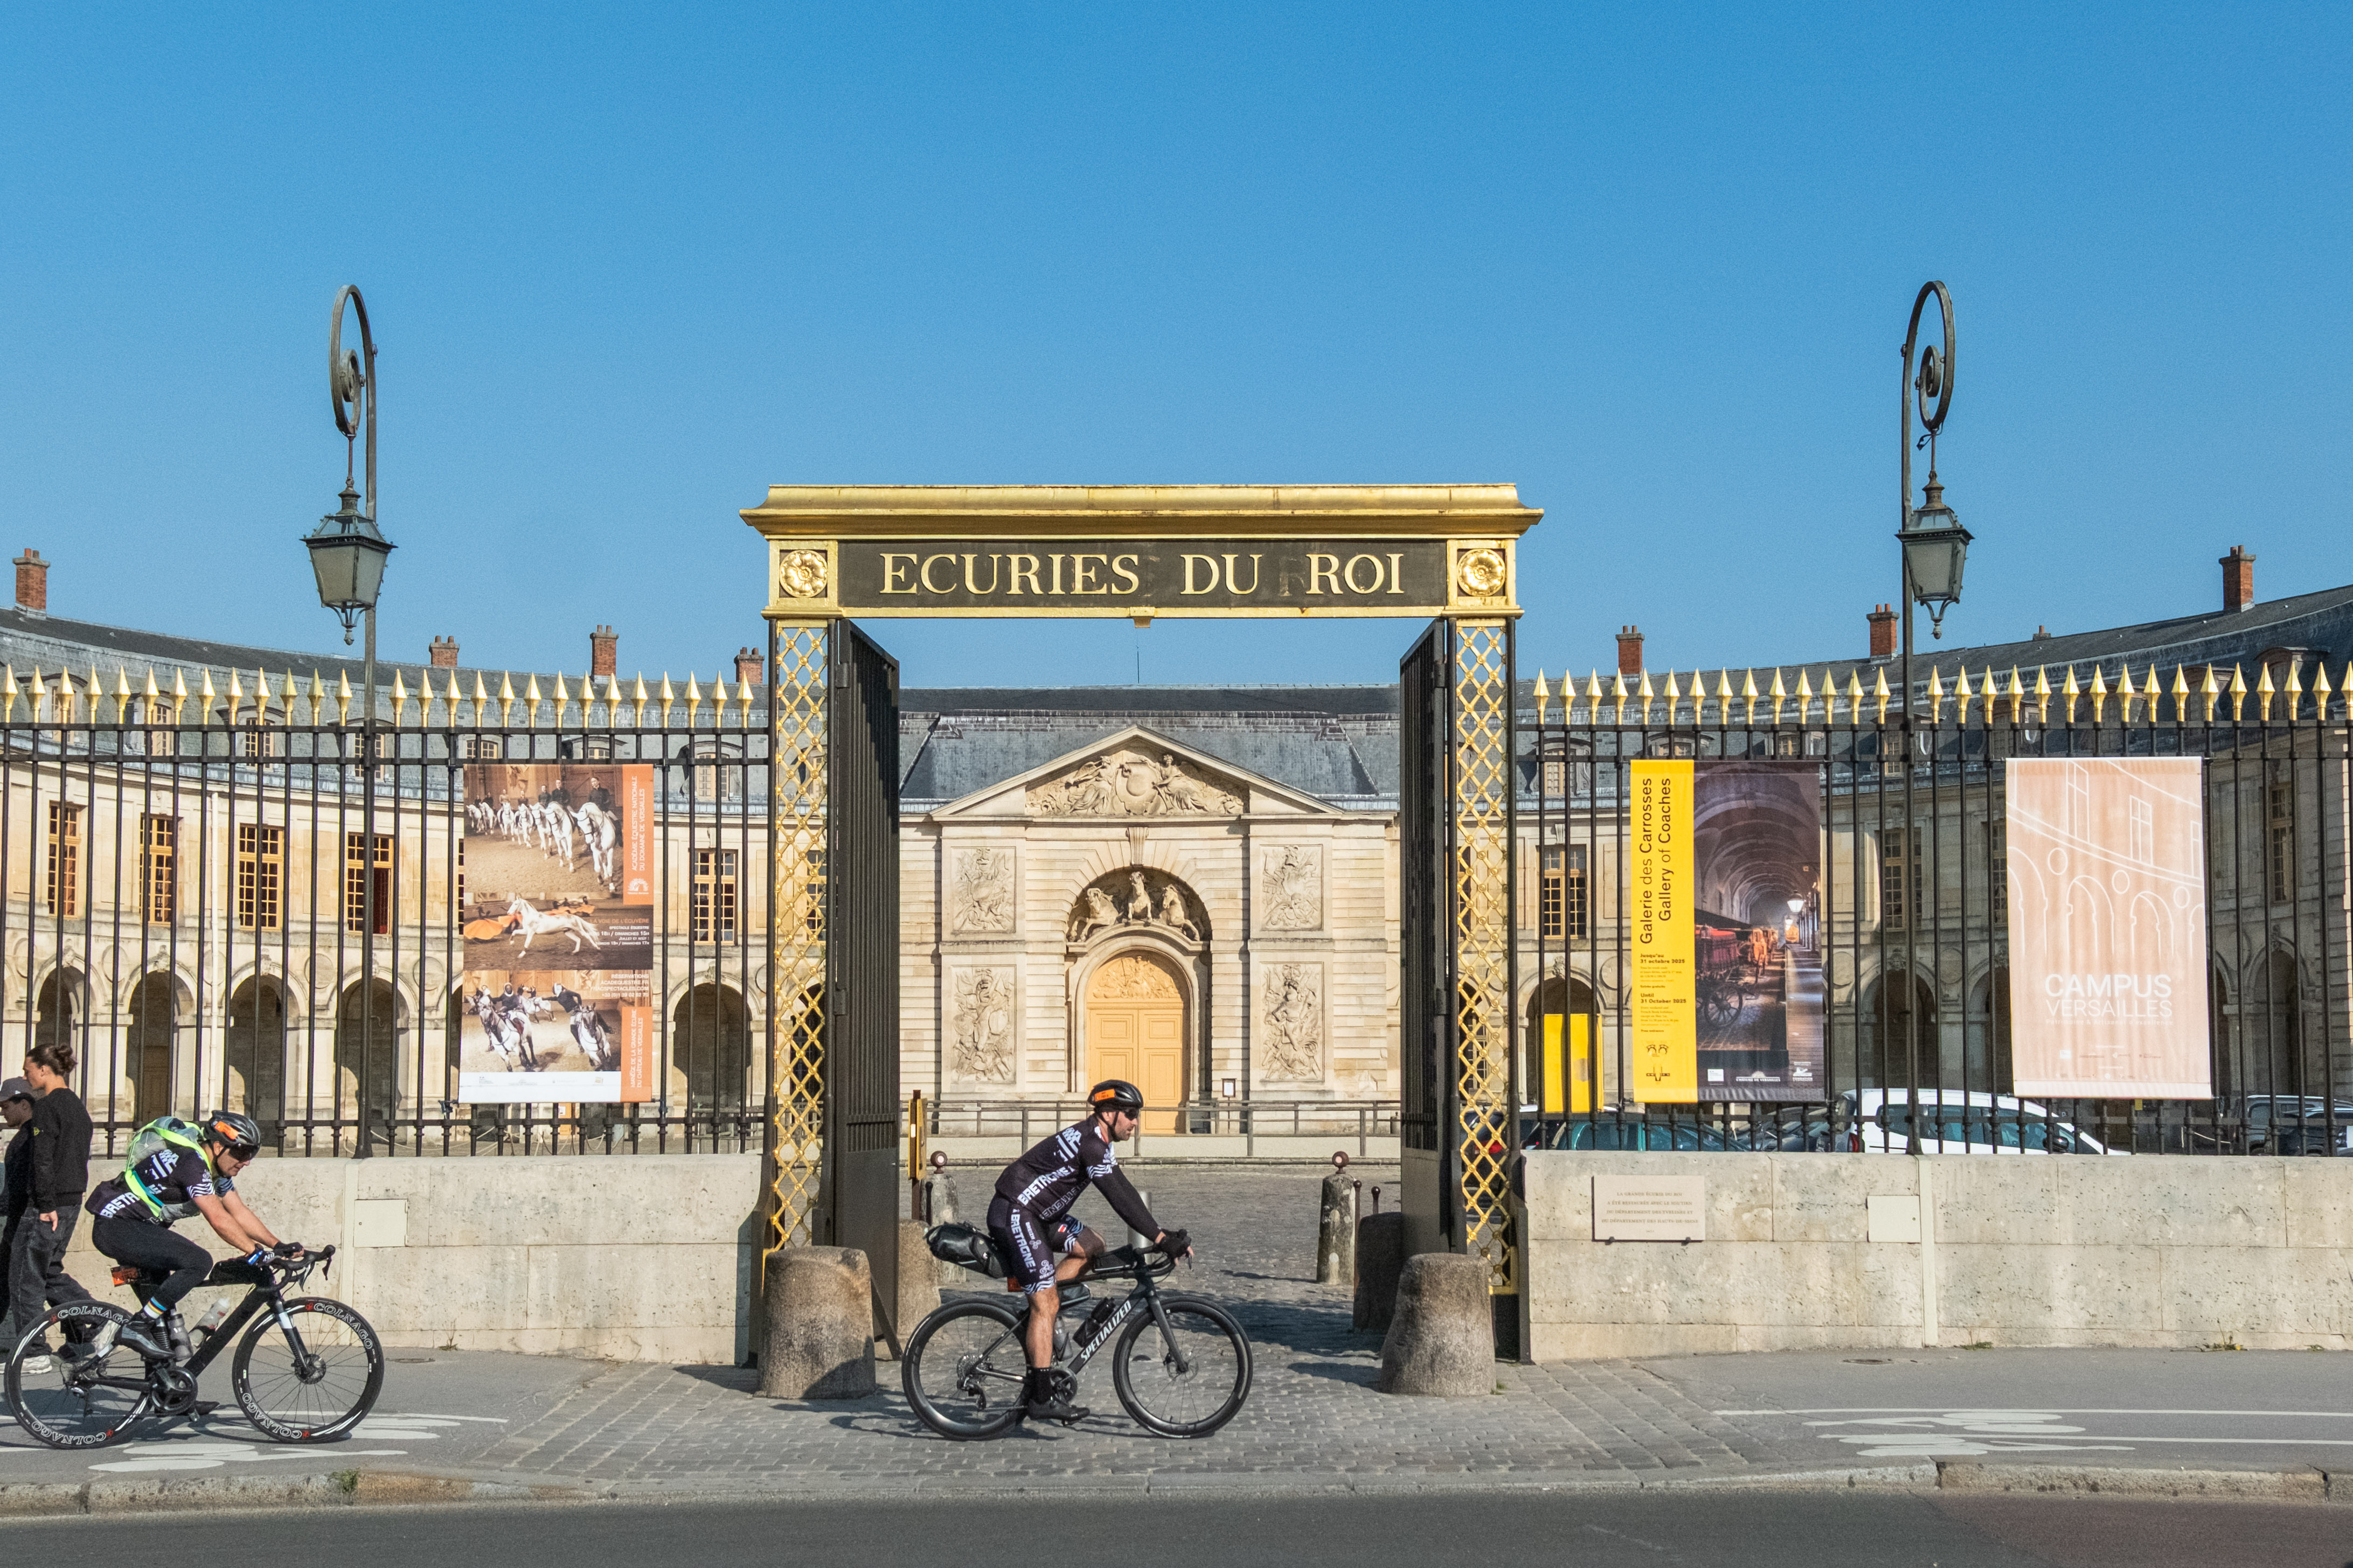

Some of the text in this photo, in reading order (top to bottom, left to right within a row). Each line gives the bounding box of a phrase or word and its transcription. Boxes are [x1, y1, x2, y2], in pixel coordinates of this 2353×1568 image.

[880, 553, 1404, 595] ECURIES DU ROI
[640, 824, 645, 832] DE
[639, 863, 645, 871] DU
[1639, 778, 1653, 944] Galerie des Carrosses
[1658, 778, 1674, 921] Gallery of Coaches
[2045, 974, 2172, 997] CAMPUS
[2046, 1000, 2172, 1017] VERSAILLES
[1017, 1166, 1069, 1205] BRETAGNE
[1011, 1214, 1036, 1269] BRETAGNE
[314, 1302, 373, 1349] COLNAGO
[1080, 1300, 1132, 1364] SPECIALIZED
[31, 1420, 107, 1445] COLNAGO
[242, 1392, 302, 1439] COLNAGO
